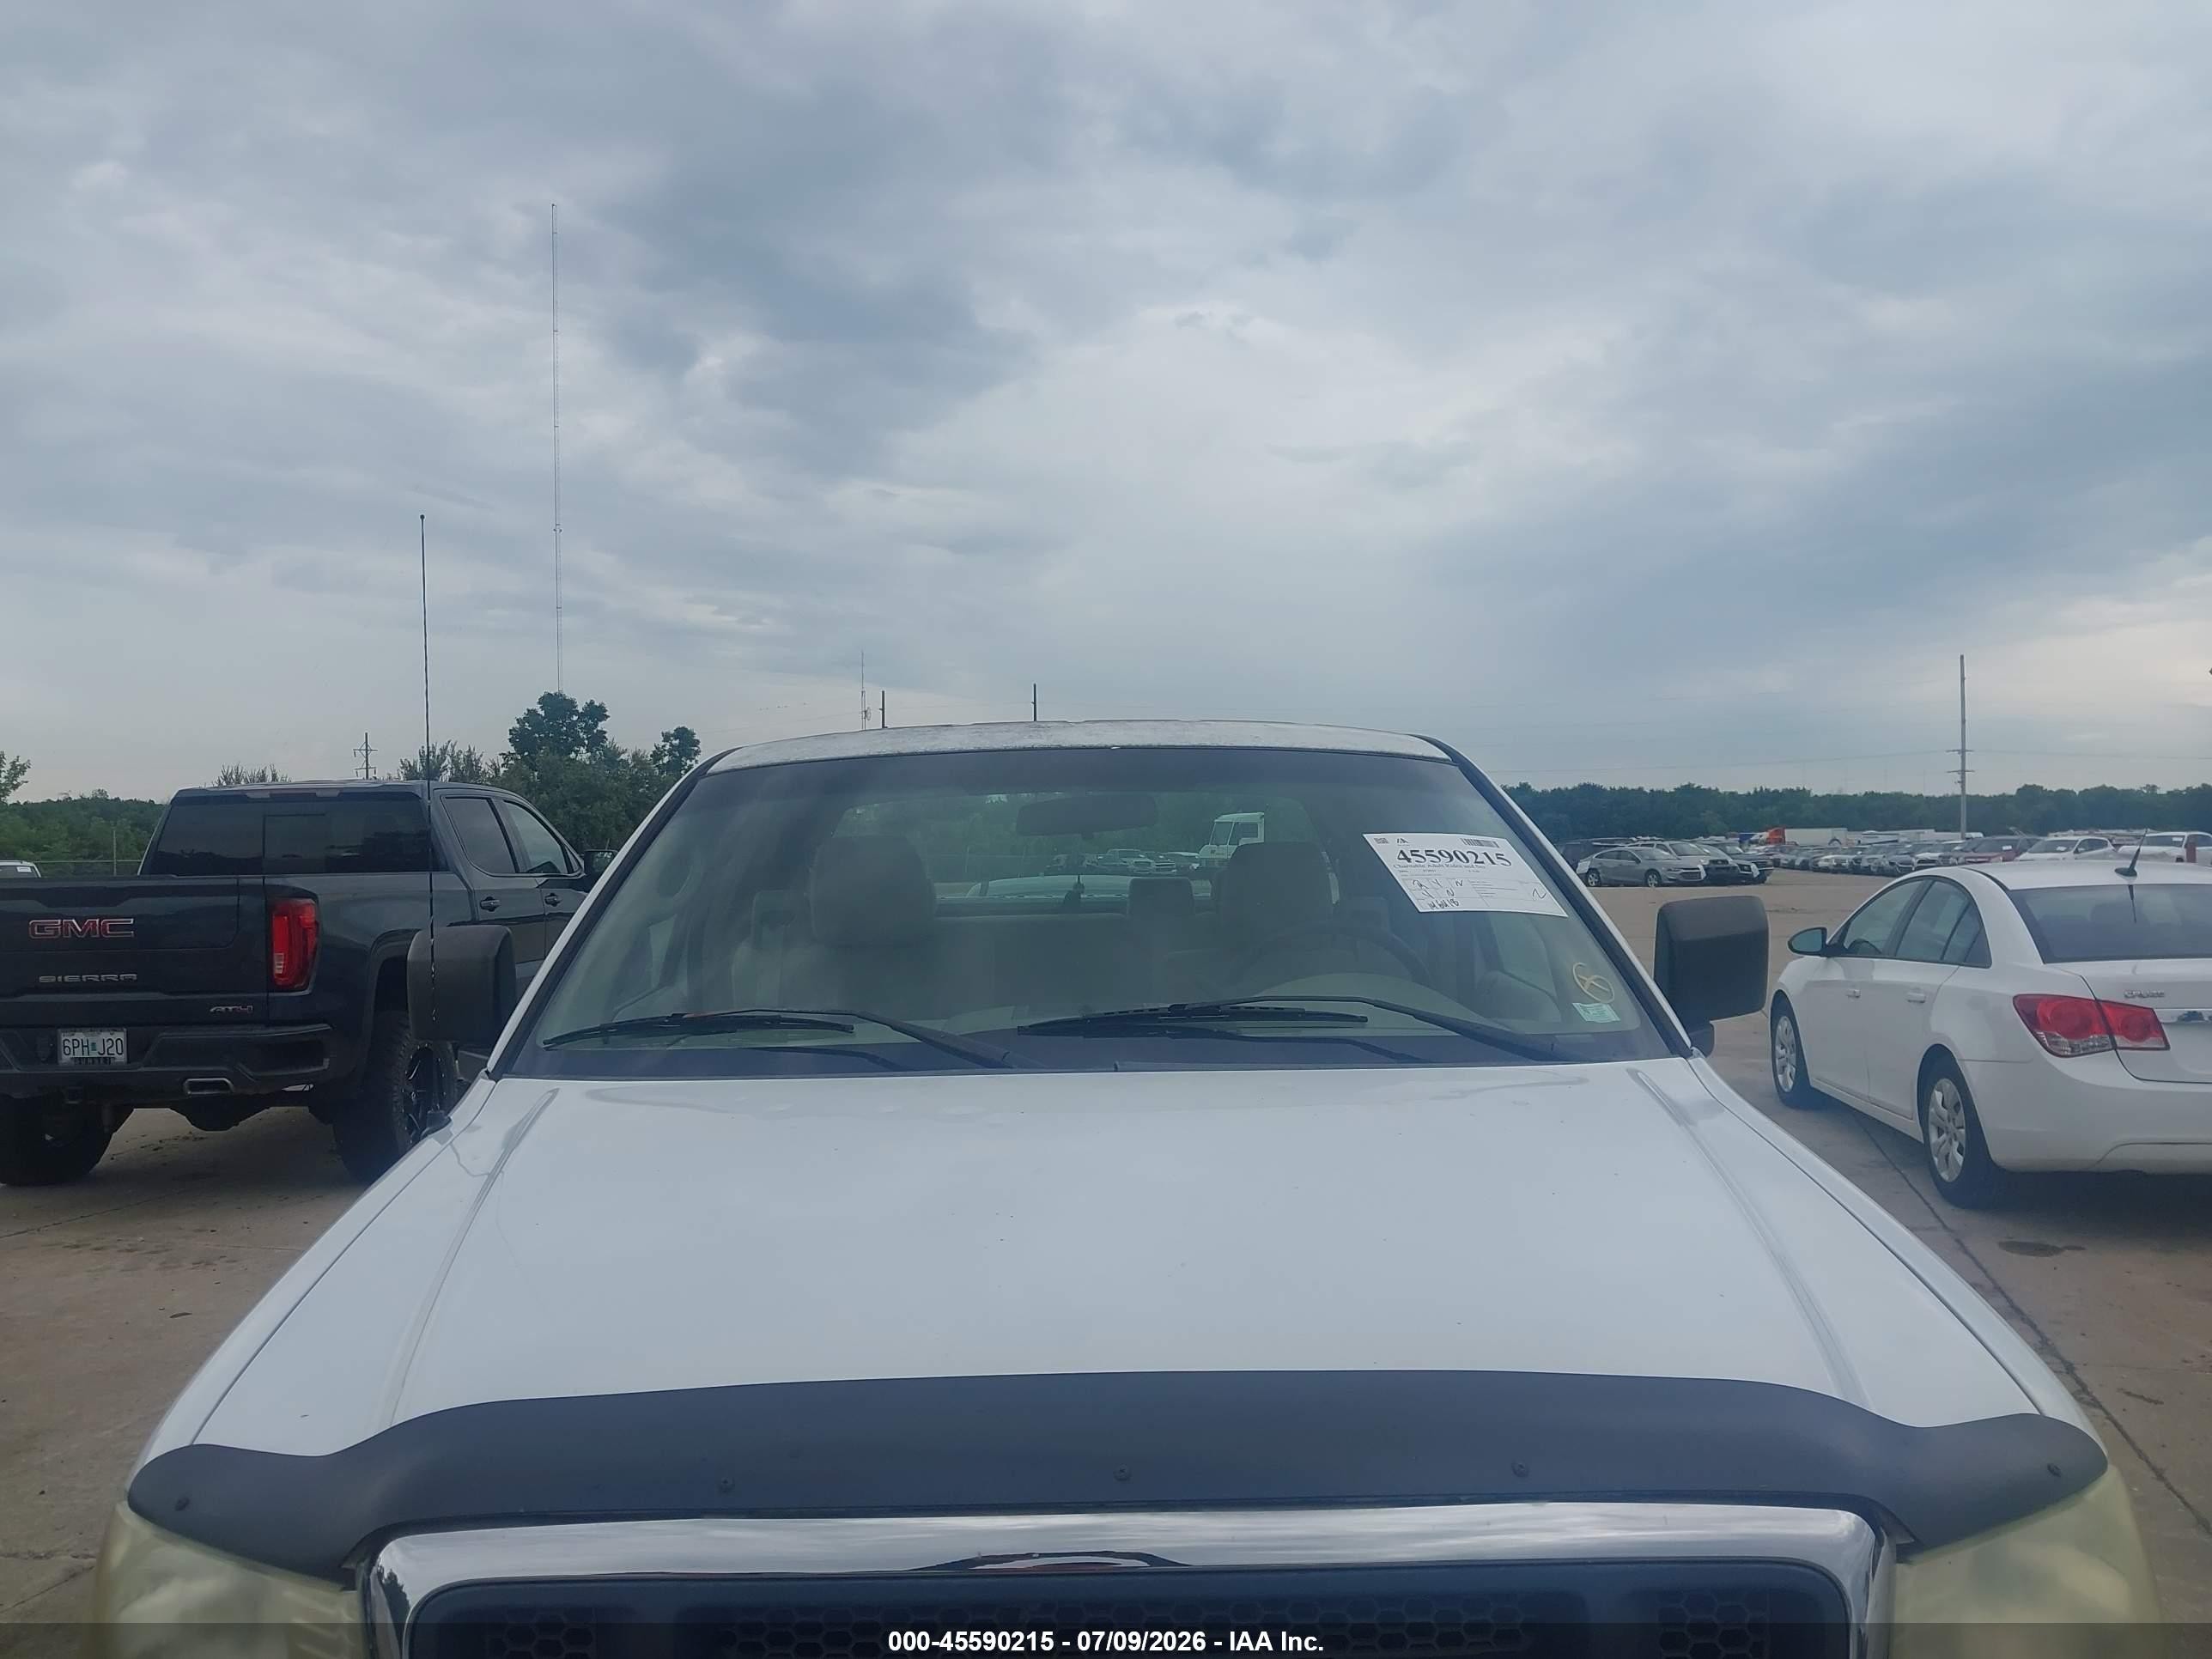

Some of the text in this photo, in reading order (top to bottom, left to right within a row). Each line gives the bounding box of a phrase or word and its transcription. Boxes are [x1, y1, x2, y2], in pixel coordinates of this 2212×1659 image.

[1396, 849, 1512, 867] 45590215
[28, 918, 134, 939] GMC
[39, 973, 137, 983] SIERRA
[210, 1005, 253, 1014] AT4
[63, 1037, 124, 1056] 6PH J20
